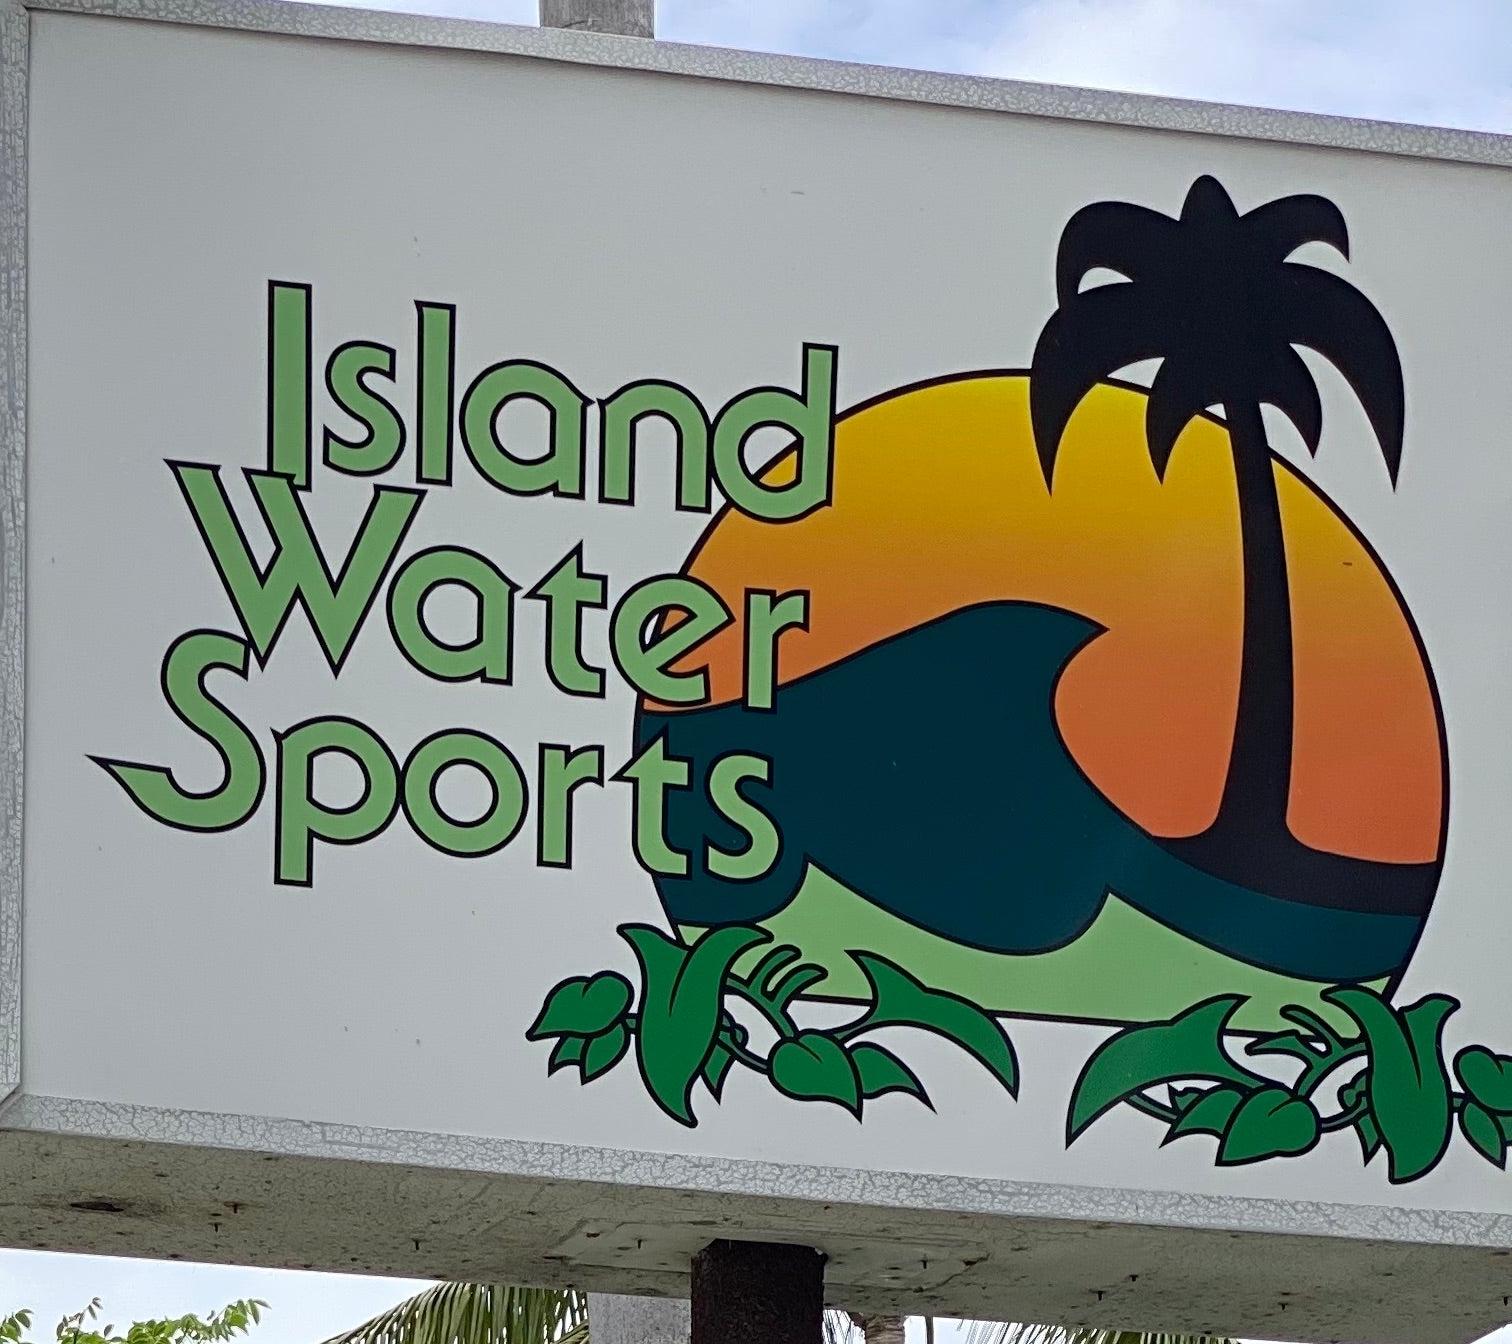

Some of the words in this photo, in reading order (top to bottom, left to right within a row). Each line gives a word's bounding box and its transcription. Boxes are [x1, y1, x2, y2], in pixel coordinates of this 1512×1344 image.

[267, 278, 839, 523] Island
[163, 458, 810, 714] Water
[84, 627, 785, 889] Sports
